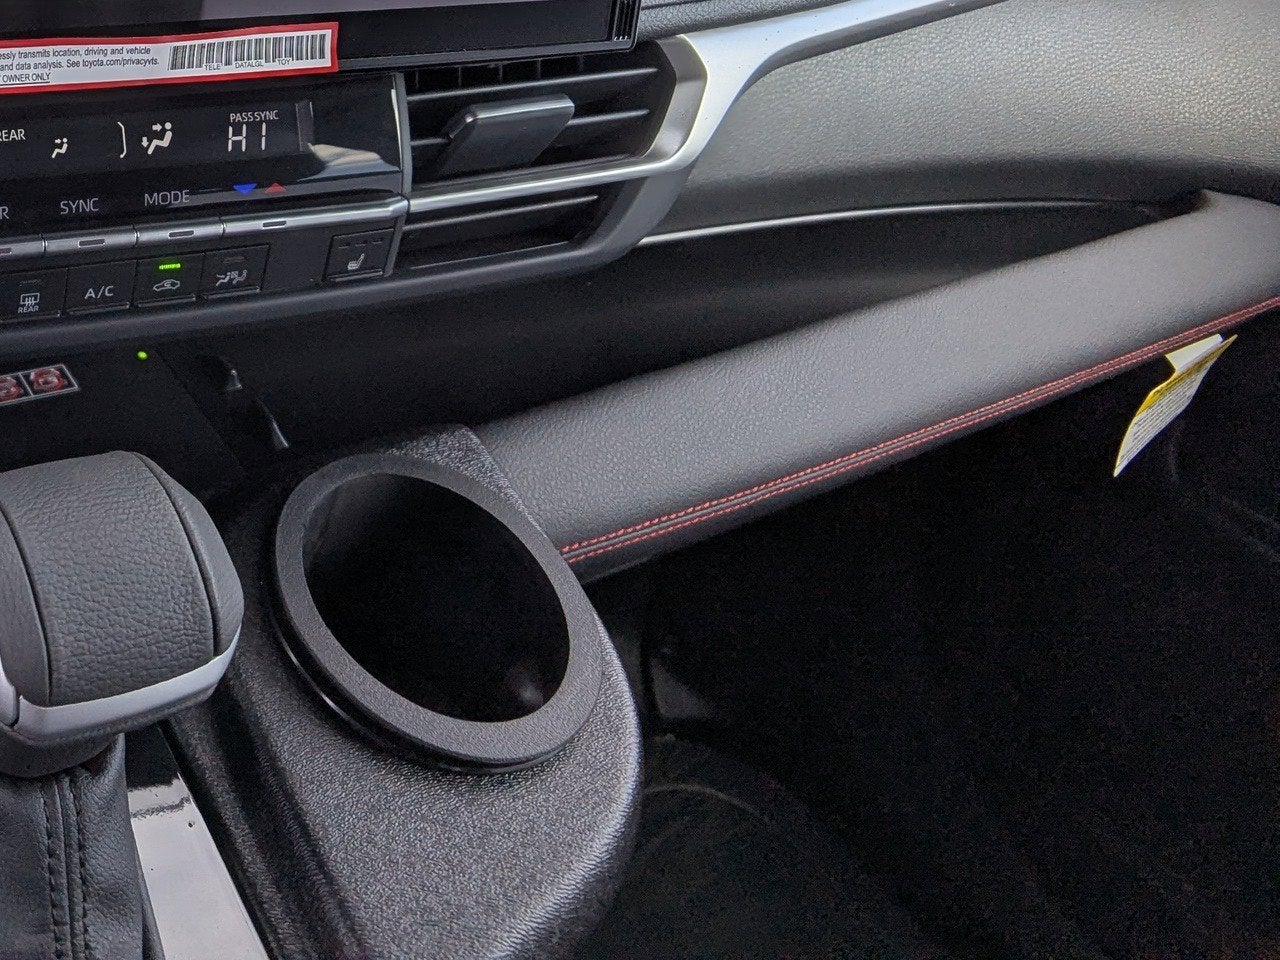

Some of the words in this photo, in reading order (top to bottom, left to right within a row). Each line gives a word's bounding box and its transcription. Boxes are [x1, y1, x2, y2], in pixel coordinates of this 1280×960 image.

[18, 49, 51, 59] transmits
[52, 48, 82, 57] location,
[84, 47, 108, 57] driving
[110, 47, 124, 55] and
[126, 46, 151, 54] vehicle
[0, 62, 14, 71] and
[15, 61, 31, 70] data
[33, 60, 64, 71] analysis.
[66, 59, 80, 68] See
[2, 73, 30, 83] OWNER
[32, 72, 51, 81] ONLY
[230, 112, 254, 122] PASS
[255, 109, 279, 121] SYNC
[144, 190, 190, 207] MODE
[60, 198, 99, 215] SYNC
[84, 285, 114, 300] A/C
[17, 304, 39, 314] REAR
